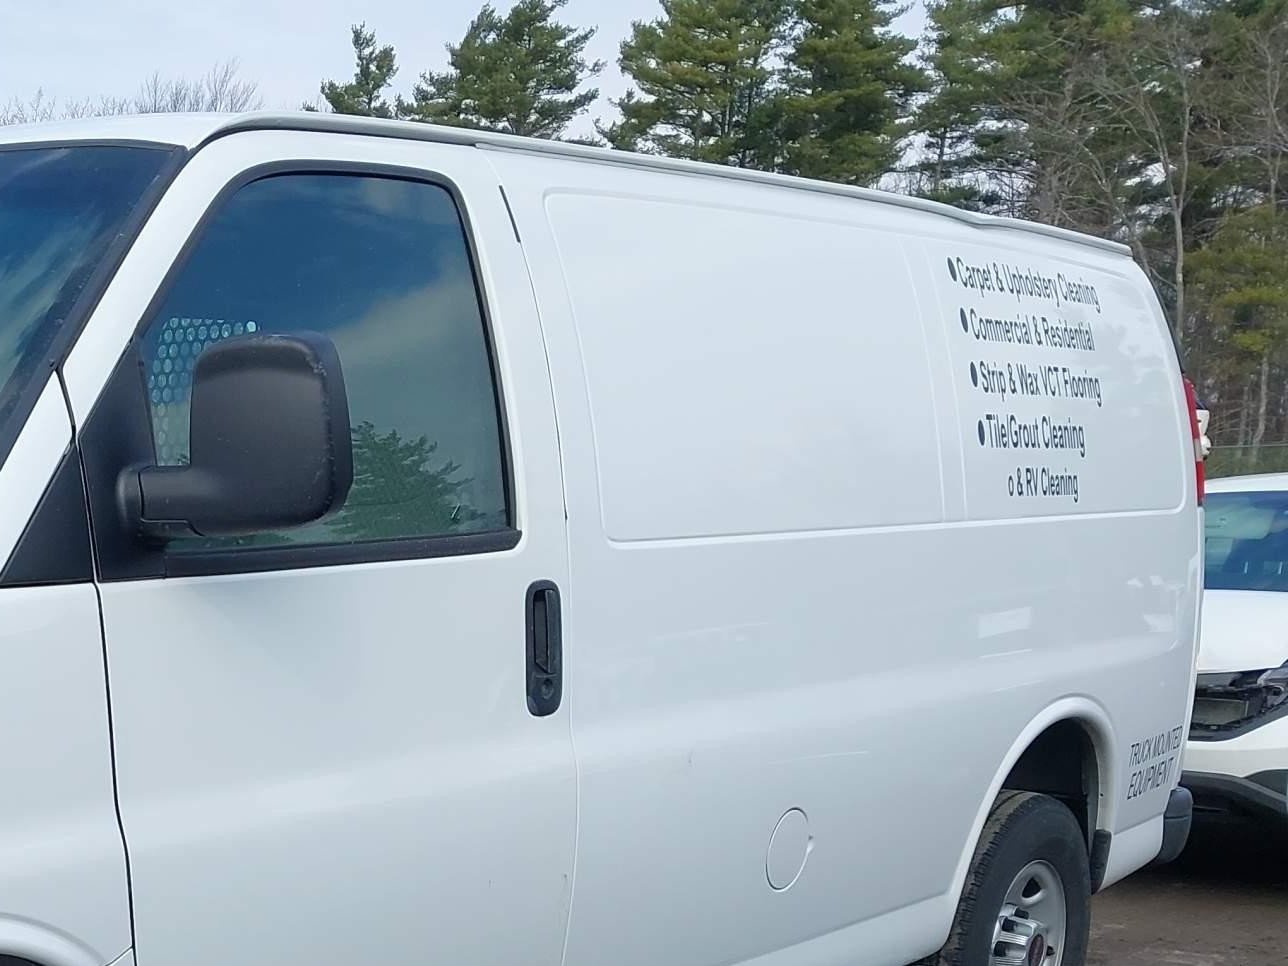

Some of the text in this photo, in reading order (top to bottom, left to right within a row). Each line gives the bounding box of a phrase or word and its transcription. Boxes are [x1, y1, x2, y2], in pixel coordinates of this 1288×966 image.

[956, 257, 1101, 312] Carpet & Upholstery Cleaning
[969, 308, 1096, 351] Commercial & Residential
[979, 361, 1103, 407] Strip & Wax VCT Flooring
[985, 413, 1086, 458] Tile/Grout Cleaning
[1016, 467, 1025, 497] &
[1025, 467, 1038, 497] RV
[1040, 467, 1079, 503] Cleaning
[1129, 737, 1155, 767] TRUCK
[1127, 756, 1174, 800] EQUIPMENT
